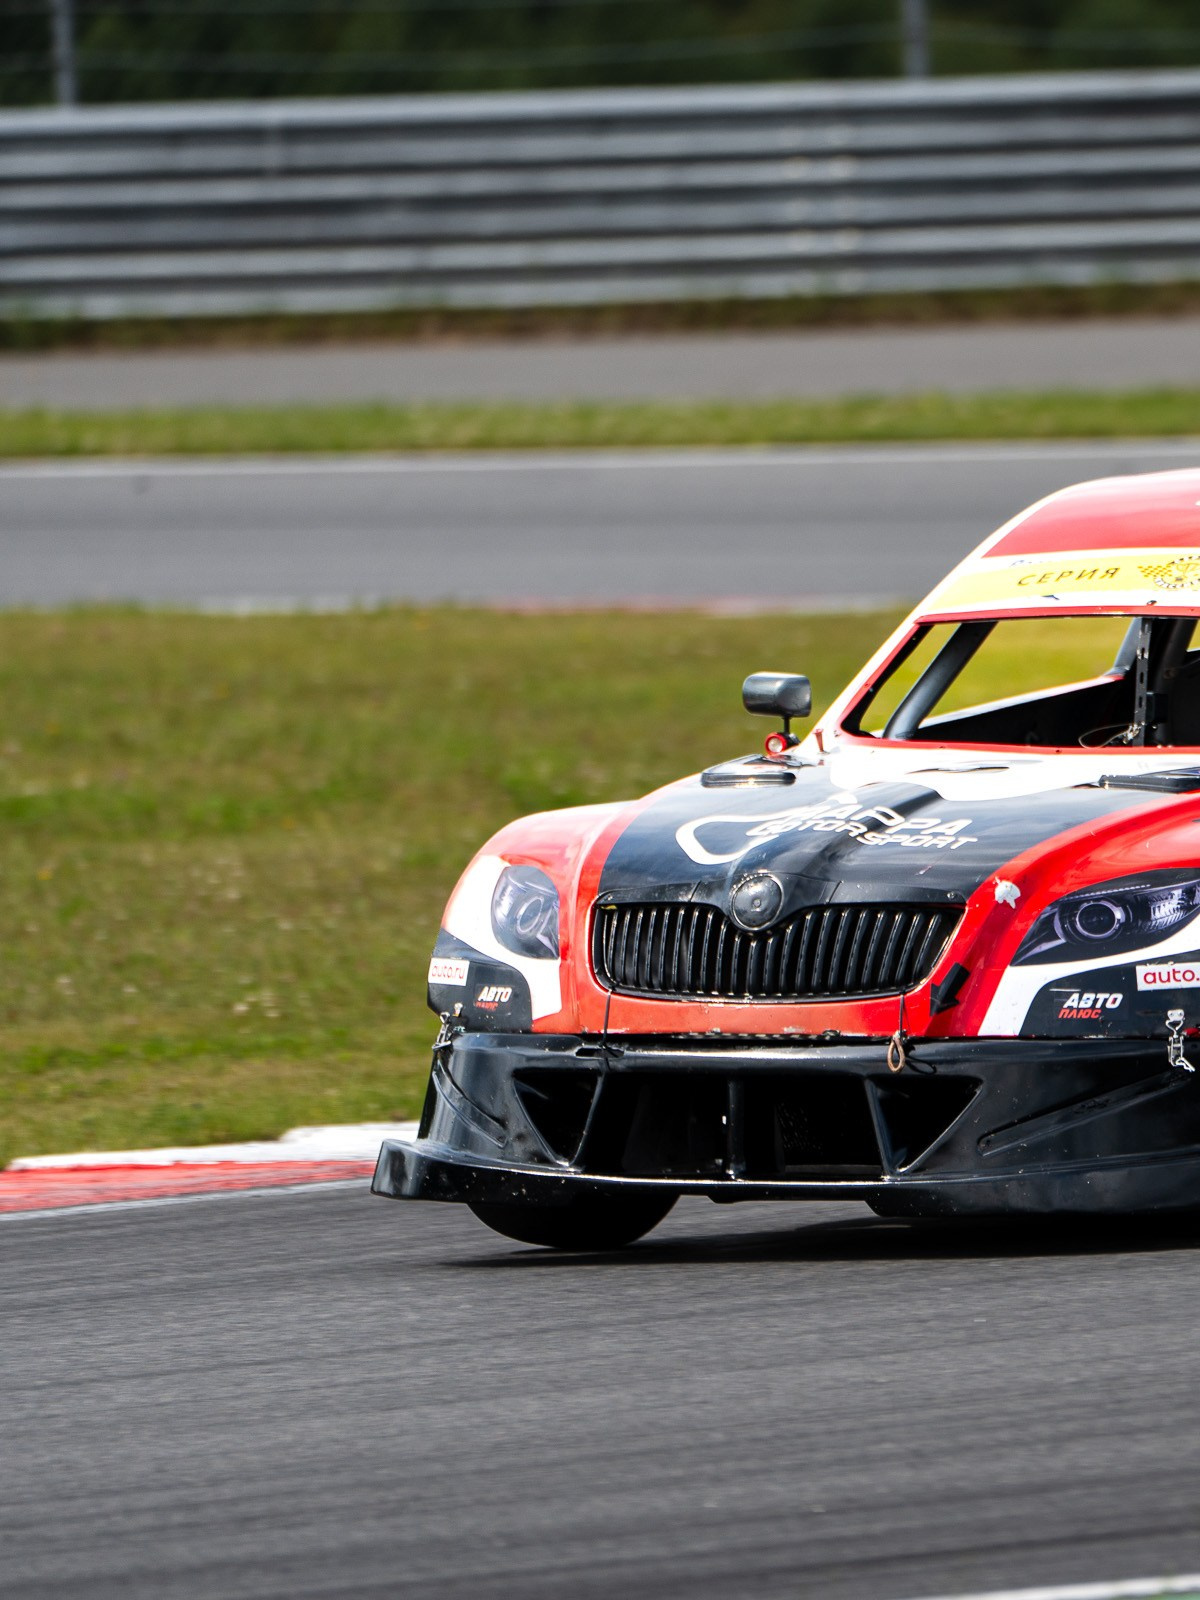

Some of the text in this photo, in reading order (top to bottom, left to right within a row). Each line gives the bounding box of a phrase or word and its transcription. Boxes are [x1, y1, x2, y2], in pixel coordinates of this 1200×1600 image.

[1016, 566, 1121, 587] СЕРИЯ
[477, 985, 513, 1003] АВТО
[1062, 992, 1124, 1009] АВТО
[1057, 1008, 1102, 1019] ПЛЮС
